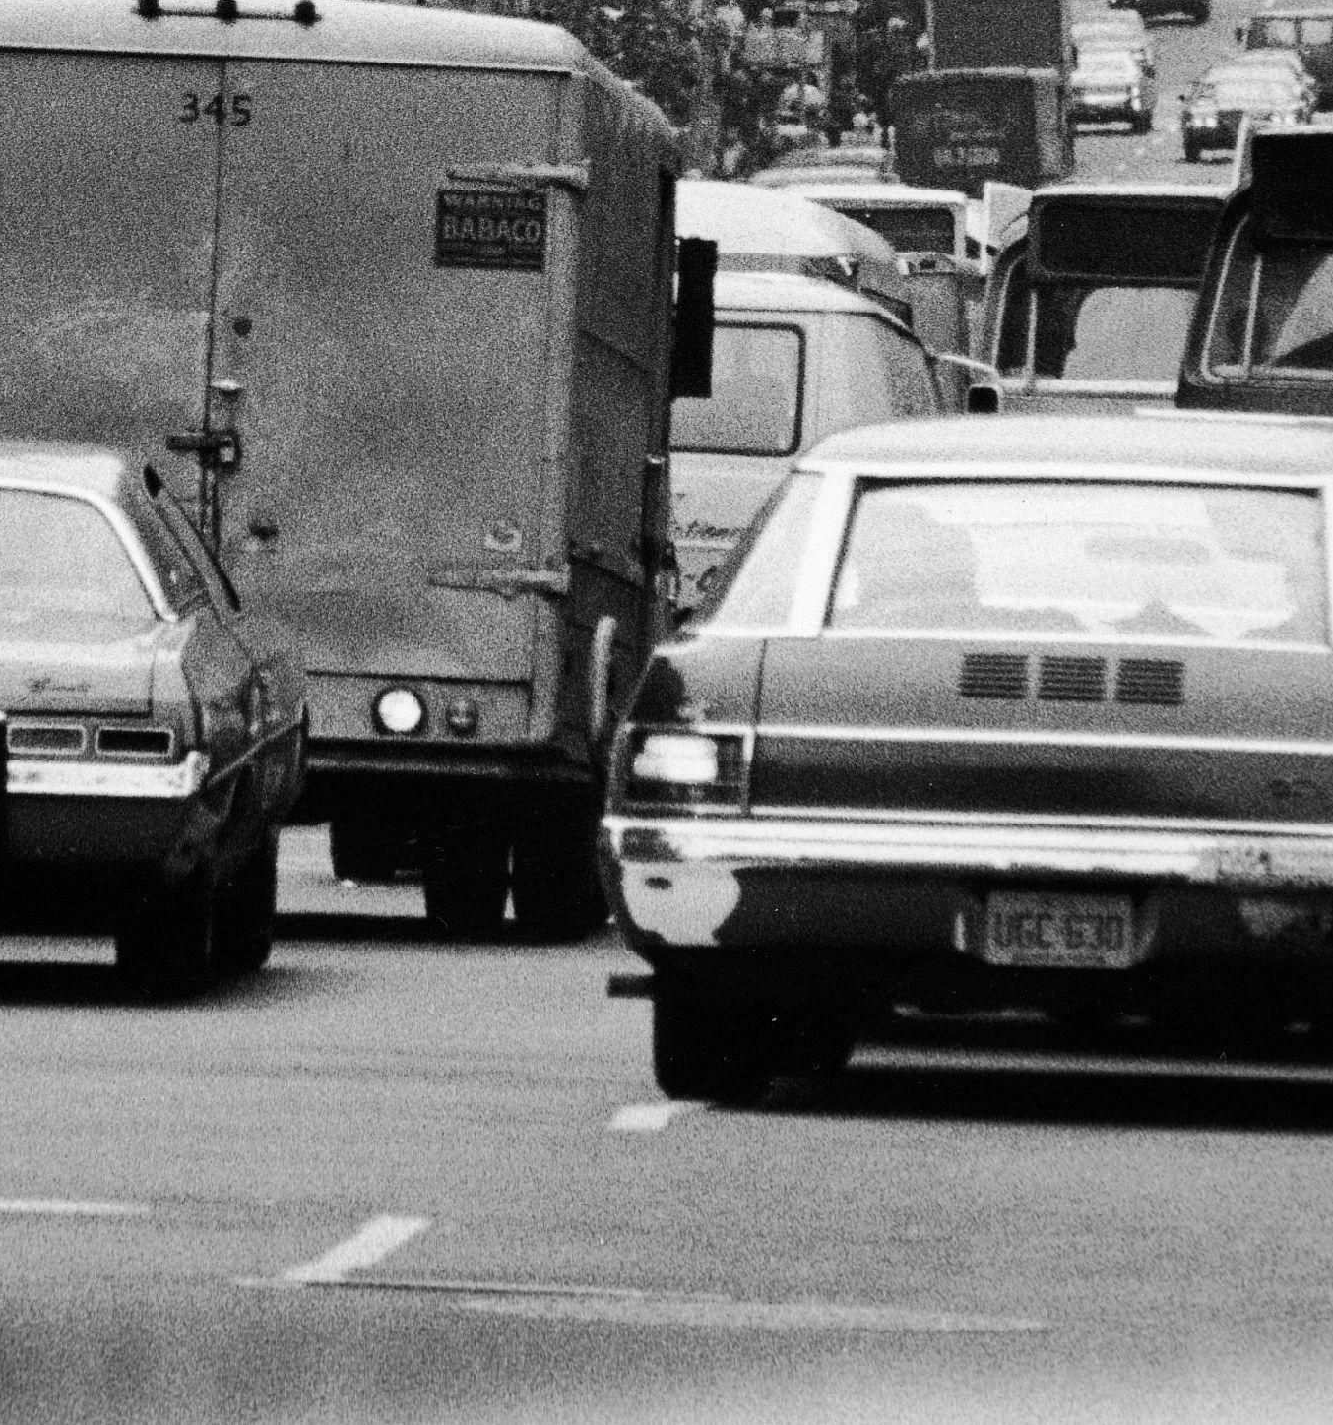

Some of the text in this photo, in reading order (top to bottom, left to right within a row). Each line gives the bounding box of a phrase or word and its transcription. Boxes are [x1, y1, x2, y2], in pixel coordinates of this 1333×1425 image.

[179, 93, 253, 127] 345
[442, 193, 543, 211] WARNING
[442, 215, 543, 243] BABACO
